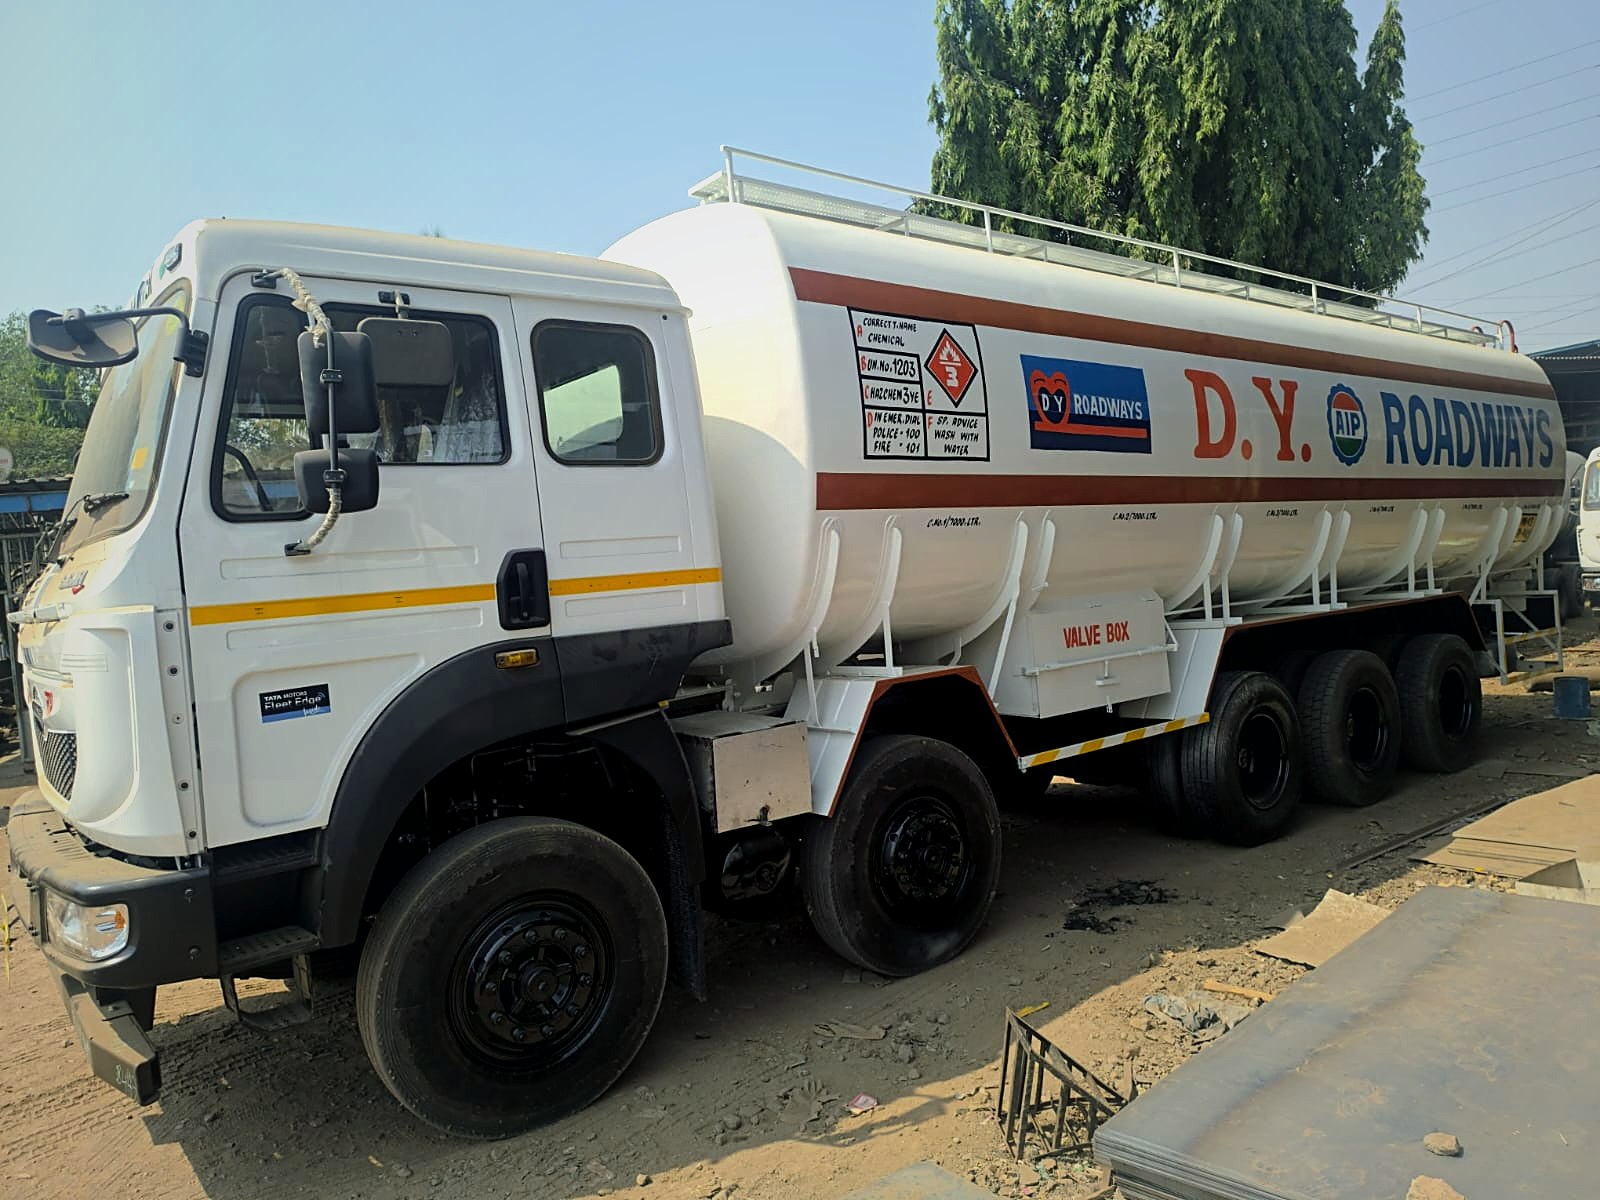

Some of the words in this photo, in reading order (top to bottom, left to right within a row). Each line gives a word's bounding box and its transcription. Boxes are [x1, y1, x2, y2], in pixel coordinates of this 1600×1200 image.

[864, 318, 891, 329] CORRECT
[857, 325, 862, 336] A
[868, 333, 904, 346] CHEMICAL
[861, 354, 866, 370] B
[945, 366, 959, 387] 3
[865, 385, 869, 400] C
[927, 390, 932, 405] E
[1073, 393, 1143, 420] ROADWAYS
[867, 414, 873, 427] D
[928, 417, 933, 429] F
[952, 417, 978, 428] ADVICE
[1335, 410, 1361, 437] AIP
[873, 427, 898, 438] POLICE
[906, 429, 920, 439] 100
[934, 430, 955, 440] WASH
[961, 432, 978, 441] WITH
[1380, 391, 1554, 468] ROADWAYS
[874, 441, 890, 453] FIRE
[906, 444, 920, 453] 101
[944, 444, 969, 455] WATER
[1063, 624, 1101, 648] VALVE
[1106, 621, 1130, 643] BOX
[264, 701, 292, 710] Fleet
[295, 696, 321, 706] Edge
